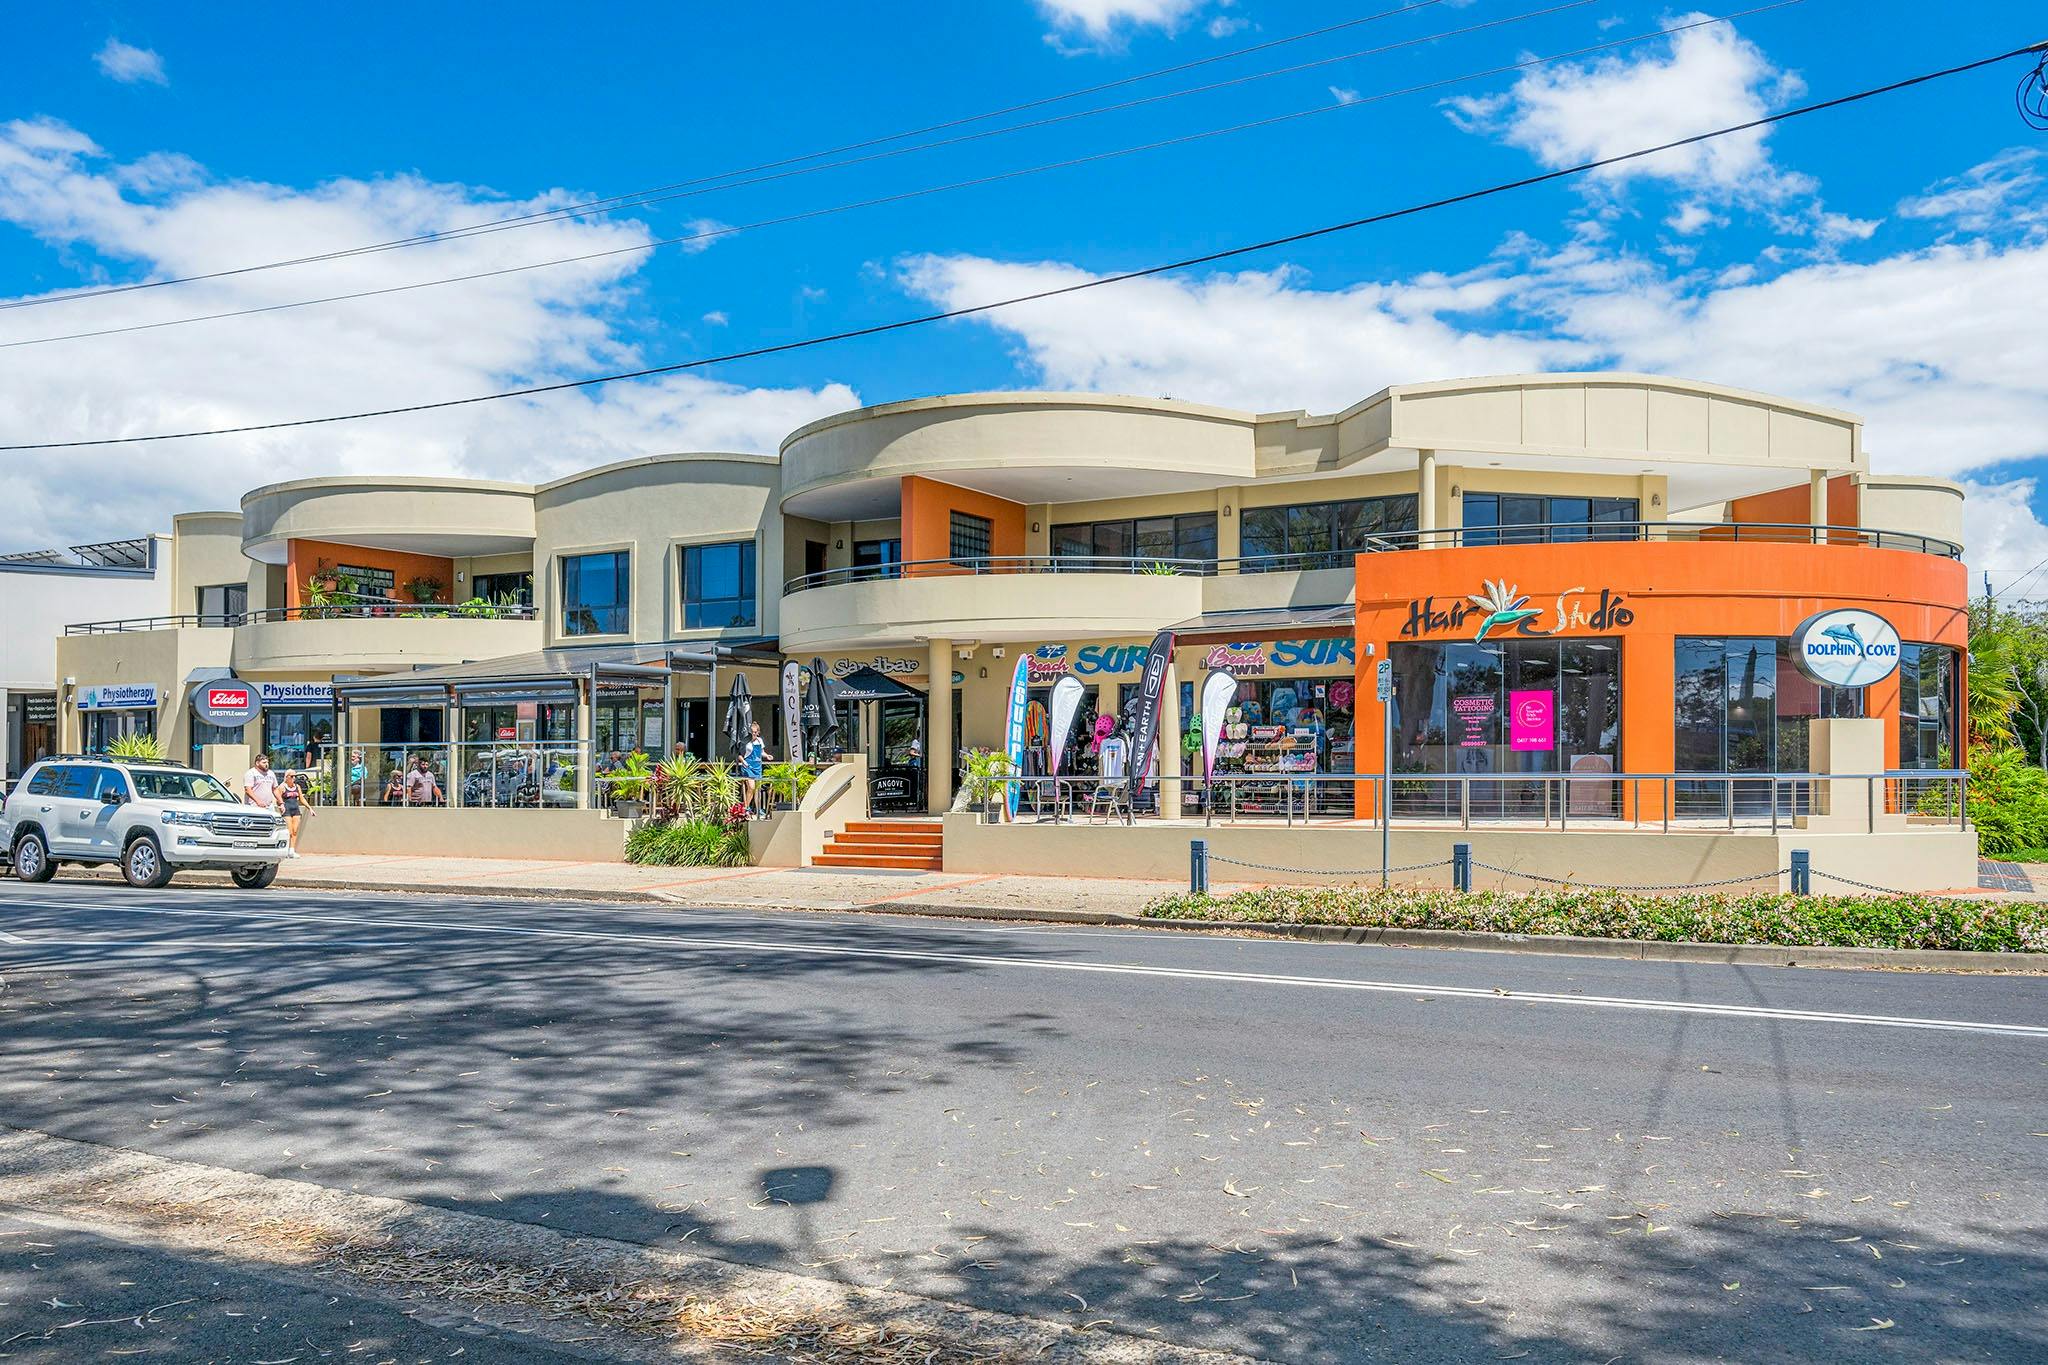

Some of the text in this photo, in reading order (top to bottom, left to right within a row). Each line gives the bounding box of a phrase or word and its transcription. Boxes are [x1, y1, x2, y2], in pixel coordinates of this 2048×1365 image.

[1401, 587, 1634, 637] Hair Studio
[1207, 646, 1266, 666] Beach
[1270, 638, 1355, 667] SUR
[1807, 643, 1896, 656] DOLPHIN COVE
[832, 656, 919, 676] Sandbar
[1027, 654, 1070, 672] Beach
[1075, 644, 1151, 674] SUR
[1028, 671, 1069, 683] OWN
[103, 686, 154, 701] Physiotherapy
[211, 693, 246, 705] Elders
[263, 684, 333, 699] Physiothera
[877, 779, 904, 790] ANGOVE
